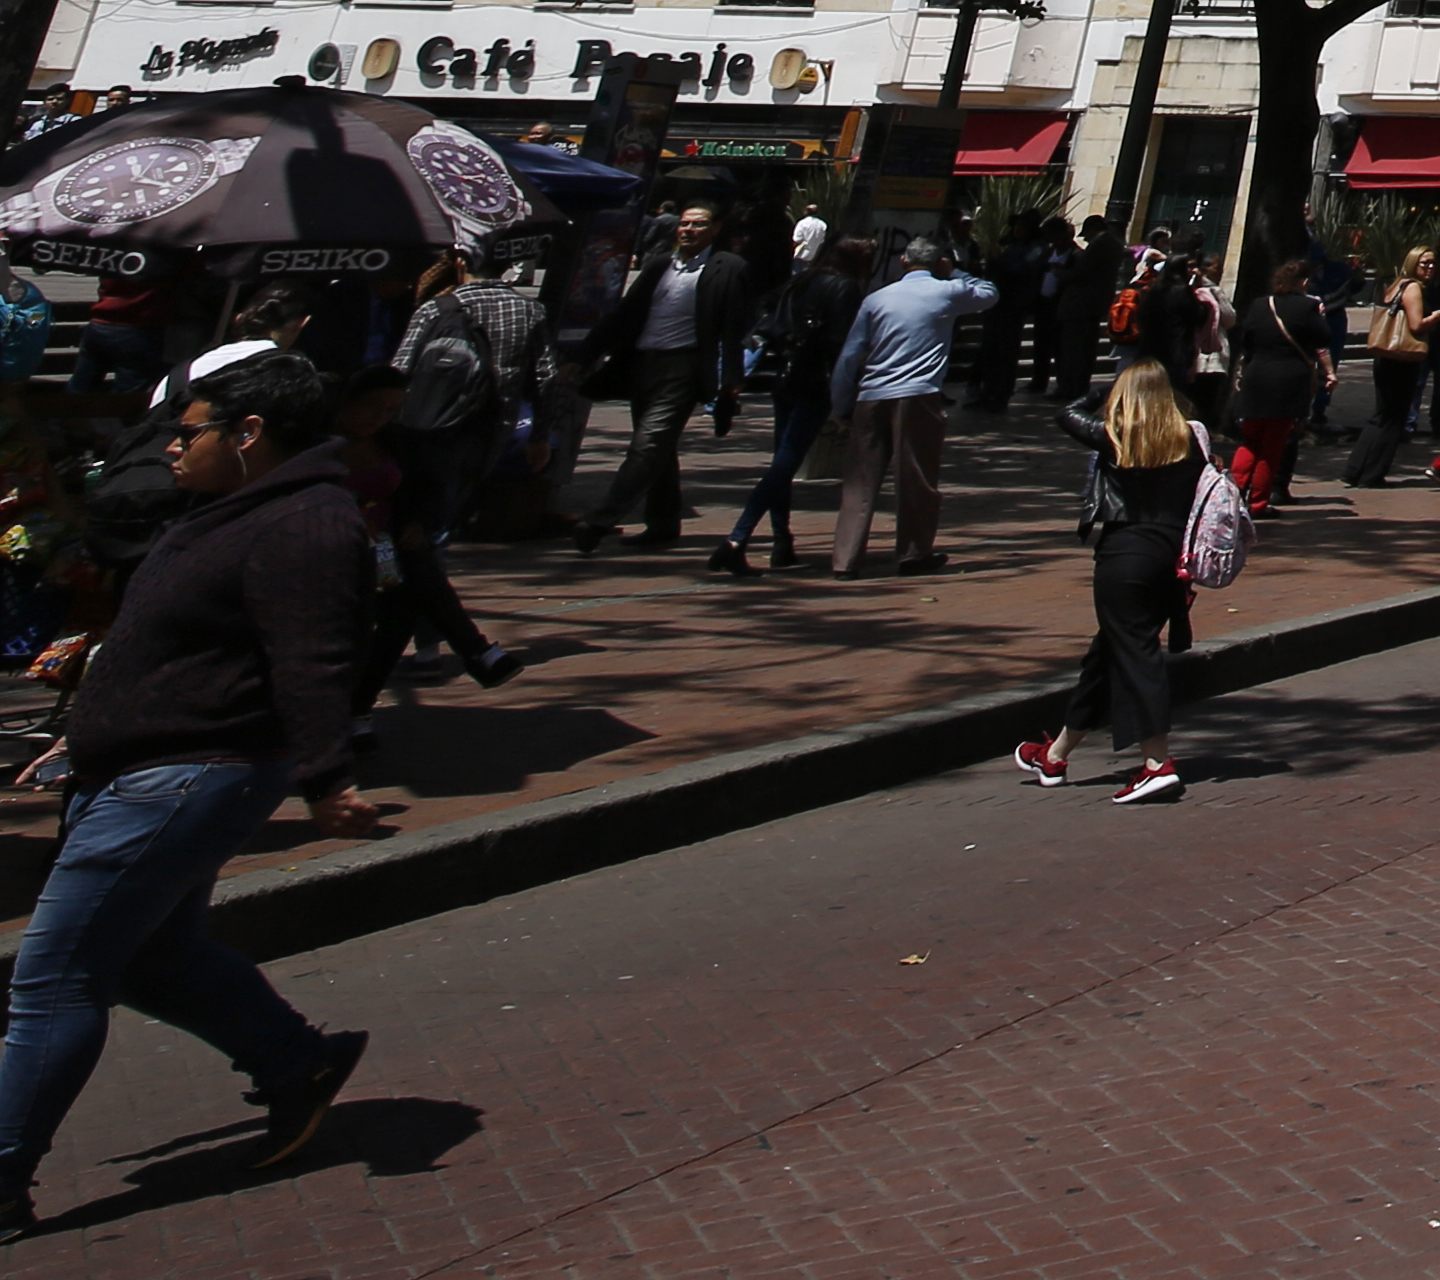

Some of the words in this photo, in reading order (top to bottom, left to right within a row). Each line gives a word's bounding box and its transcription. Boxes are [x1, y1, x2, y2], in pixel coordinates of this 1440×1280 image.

[416, 36, 537, 81] Café
[569, 39, 754, 87] Paje
[702, 141, 787, 157] Heineken
[32, 240, 146, 276] SEIKO
[260, 248, 390, 274] SEIKO
